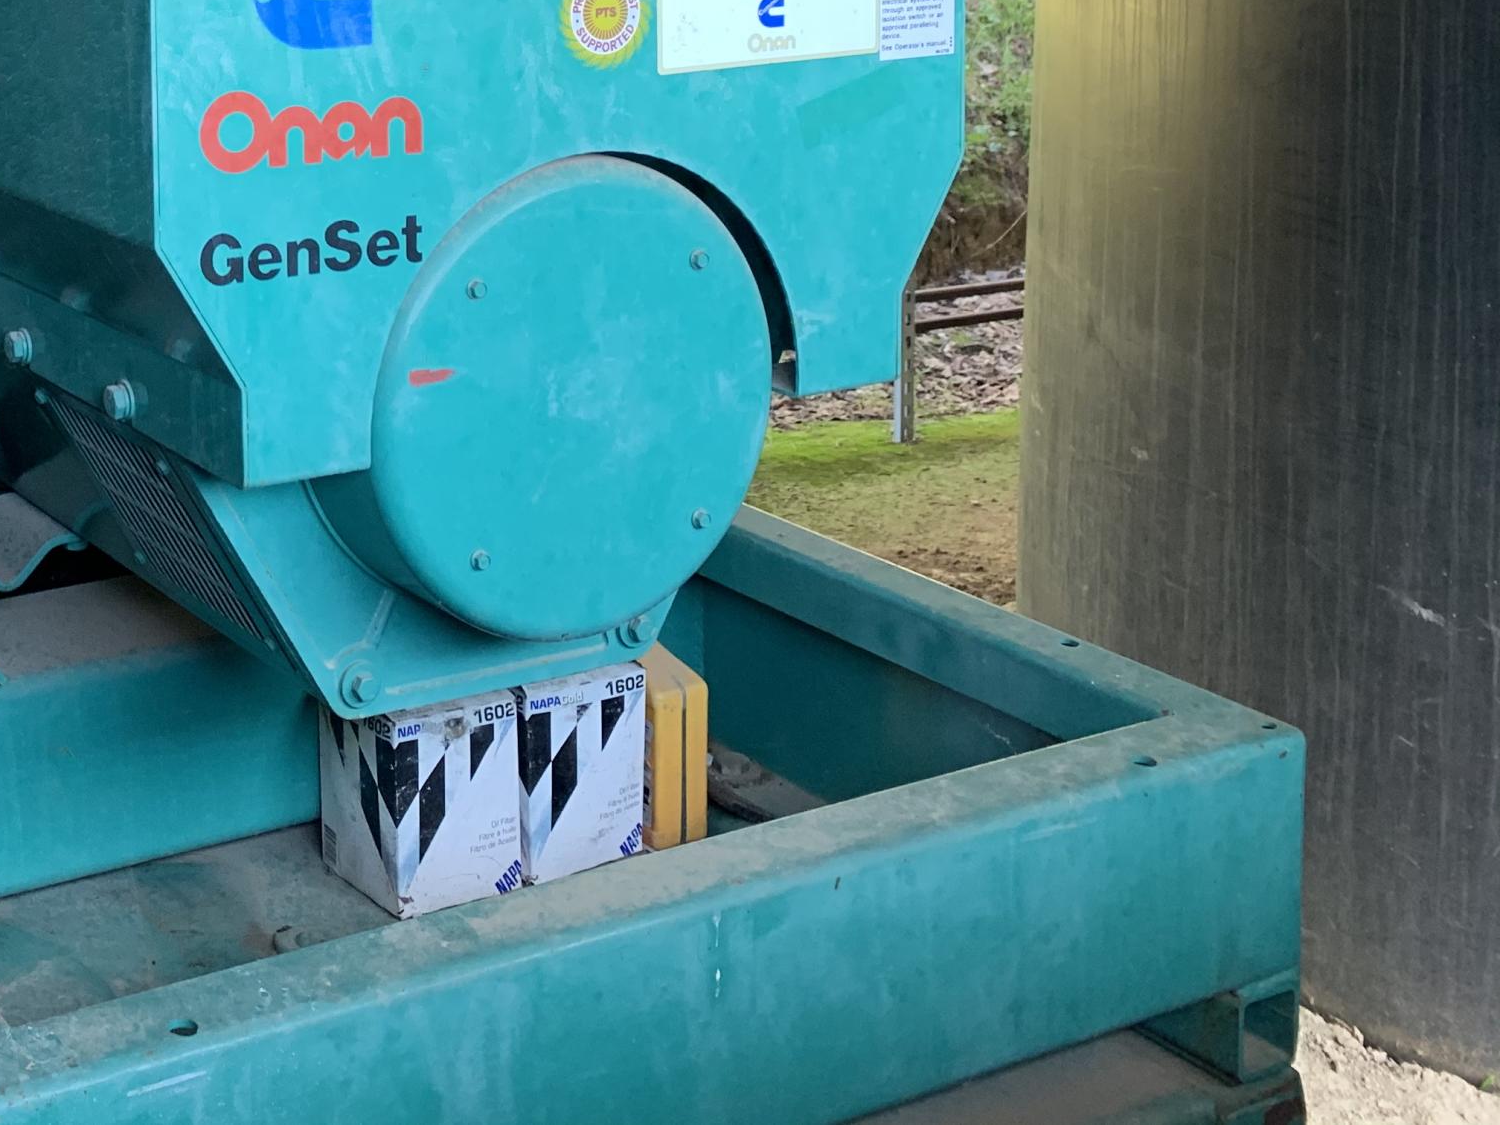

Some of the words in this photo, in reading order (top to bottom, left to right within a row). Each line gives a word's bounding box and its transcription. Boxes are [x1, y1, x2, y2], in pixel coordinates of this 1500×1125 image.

[595, 6, 617, 18] PTS
[576, 24, 635, 53] SUPPORTED
[747, 33, 797, 53] Onan
[199, 90, 424, 174] Onan
[200, 214, 423, 287] GenSet
[605, 674, 644, 696] 1602
[530, 695, 562, 711] NAPA
[397, 723, 423, 739] NAP
[473, 702, 515, 724] 1602
[619, 822, 643, 857] NAPA
[494, 859, 522, 895] NAPA
